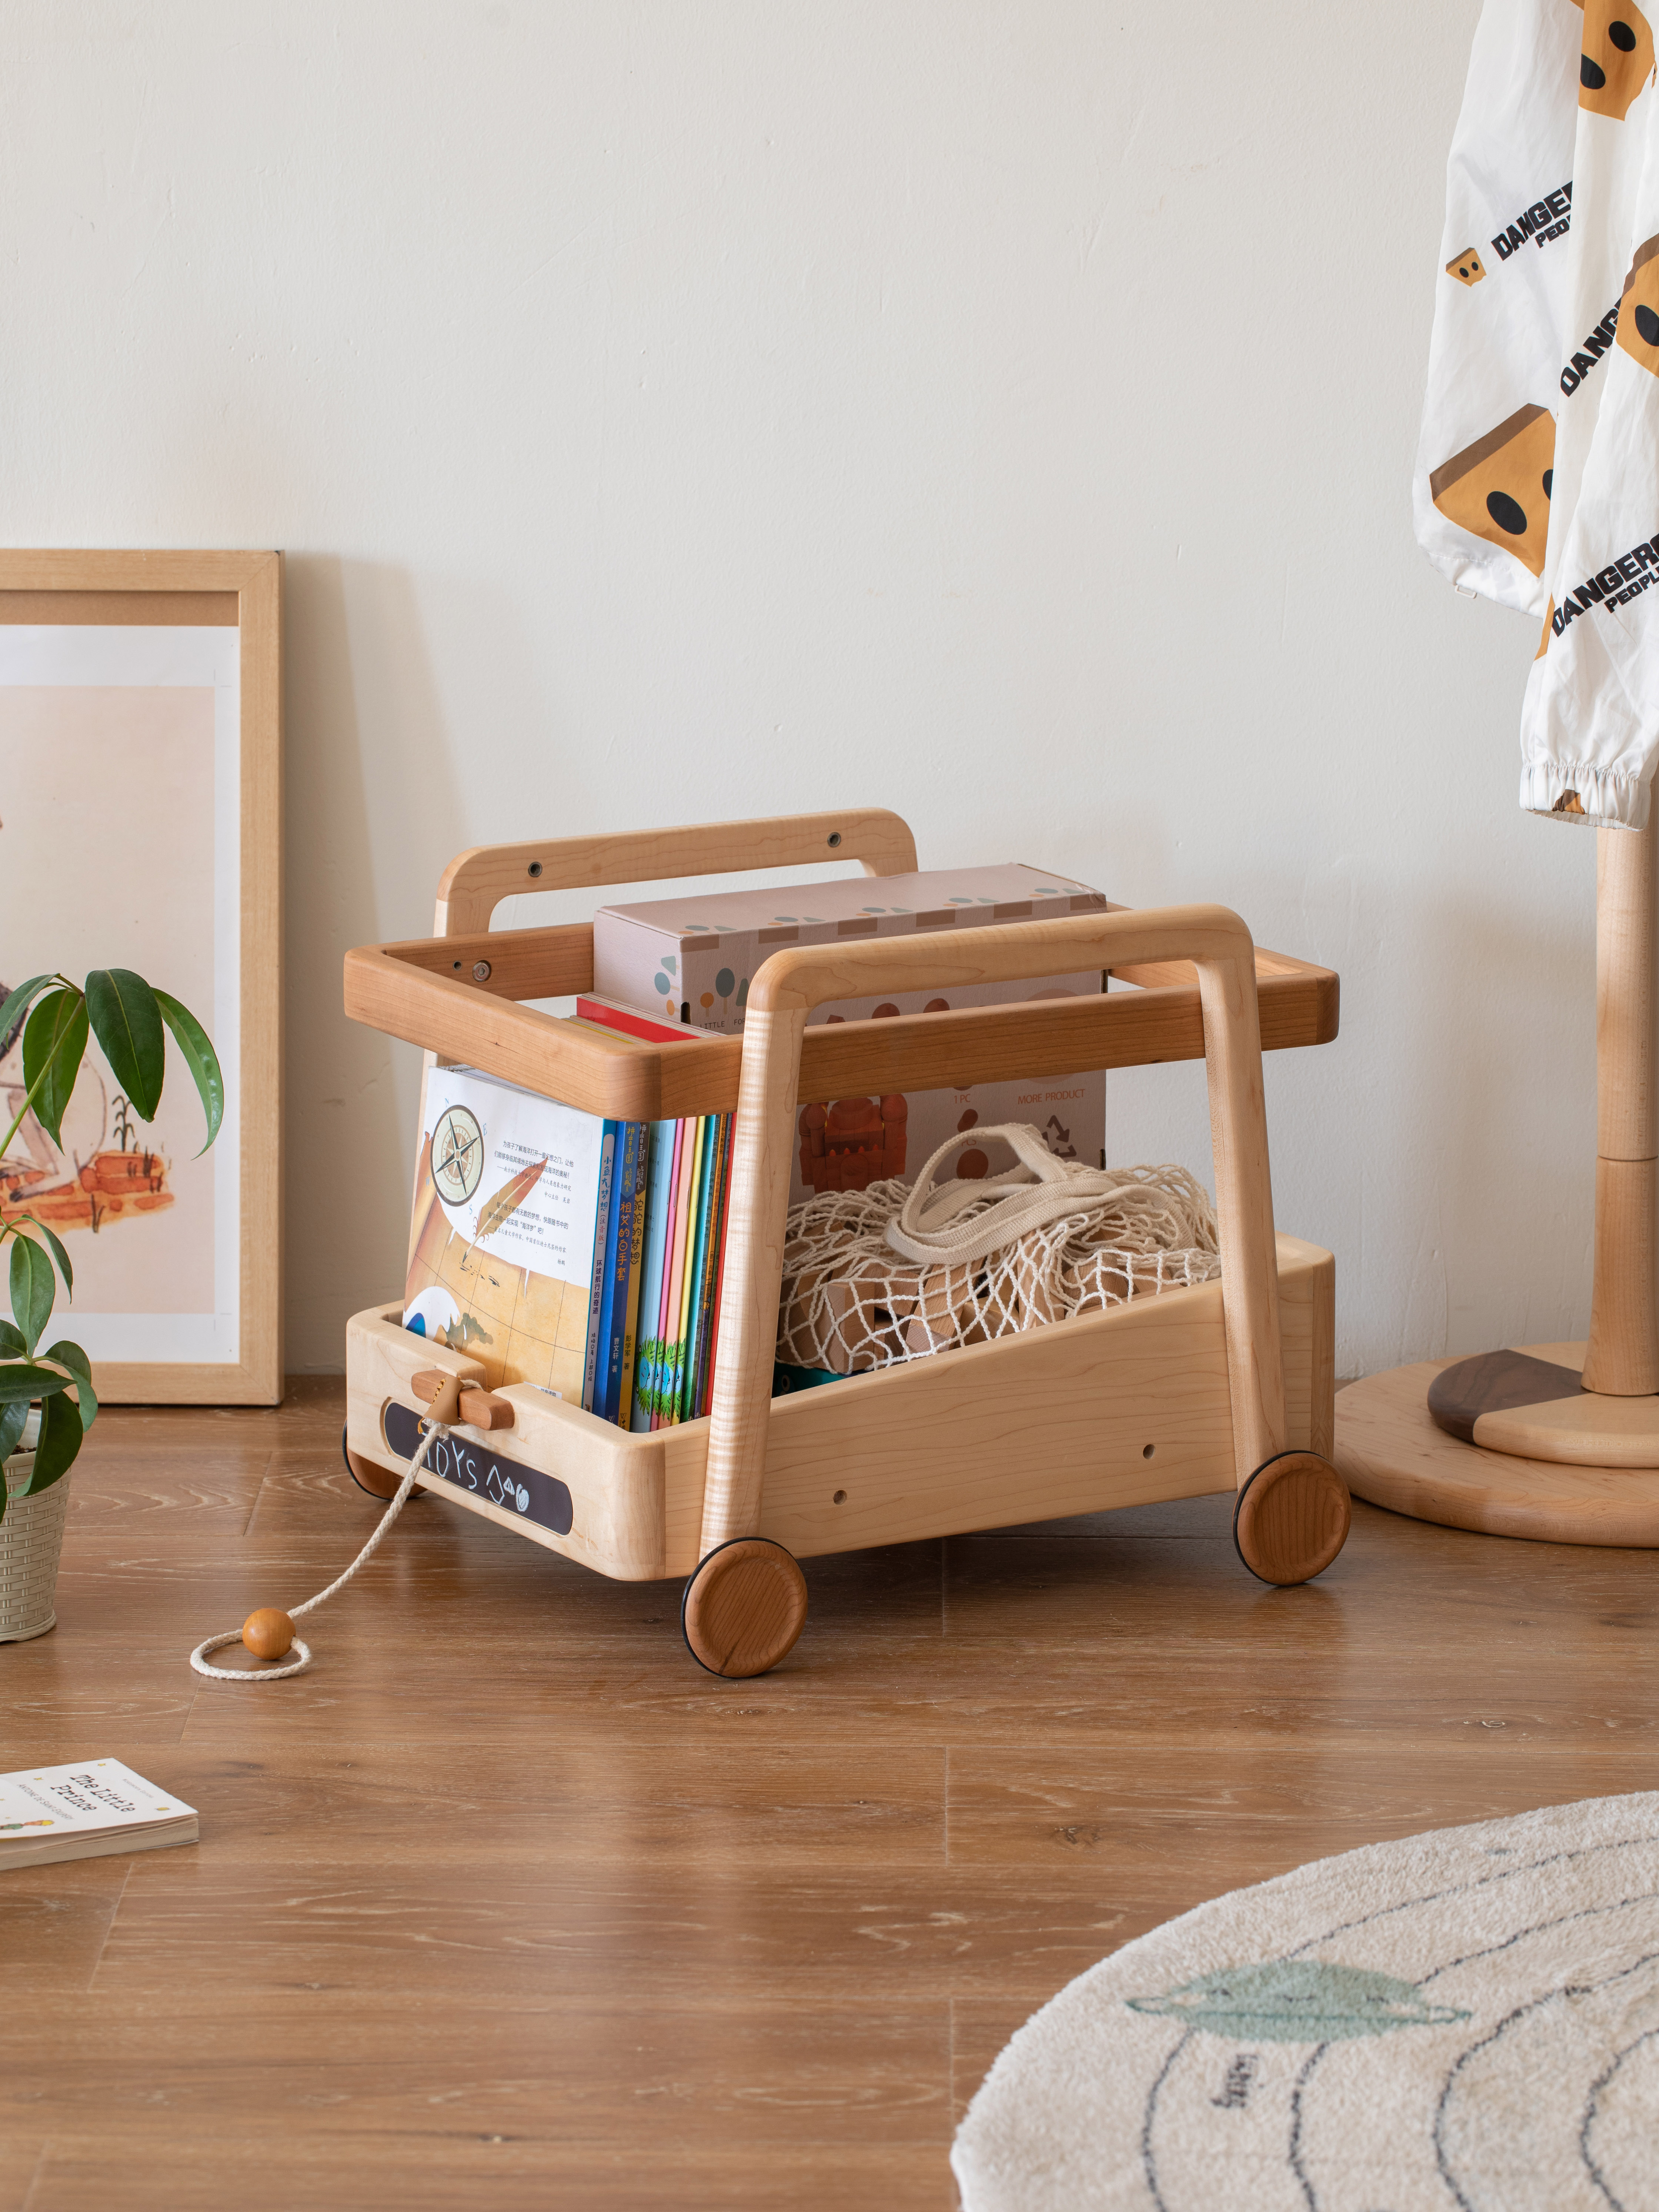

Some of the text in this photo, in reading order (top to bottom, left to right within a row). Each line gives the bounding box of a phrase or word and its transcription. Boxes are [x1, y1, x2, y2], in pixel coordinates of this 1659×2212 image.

[1535, 214, 1570, 248] PEO
[1560, 297, 1622, 397] DANG
[1604, 565, 1659, 614] PEOPL
[444, 1098, 449, 1107] N
[954, 1094, 971, 1104] 1 PC
[1018, 1089, 1085, 1105] MORE PRODUCT
[483, 1123, 487, 1136] E
[469, 1204, 473, 1215] S
[617, 1202, 631, 1281] 祖父的白手套
[592, 1260, 602, 1314] 环球航行的奇迹
[50, 1785, 97, 1811] Prince
[70, 1775, 136, 1812] The Little
